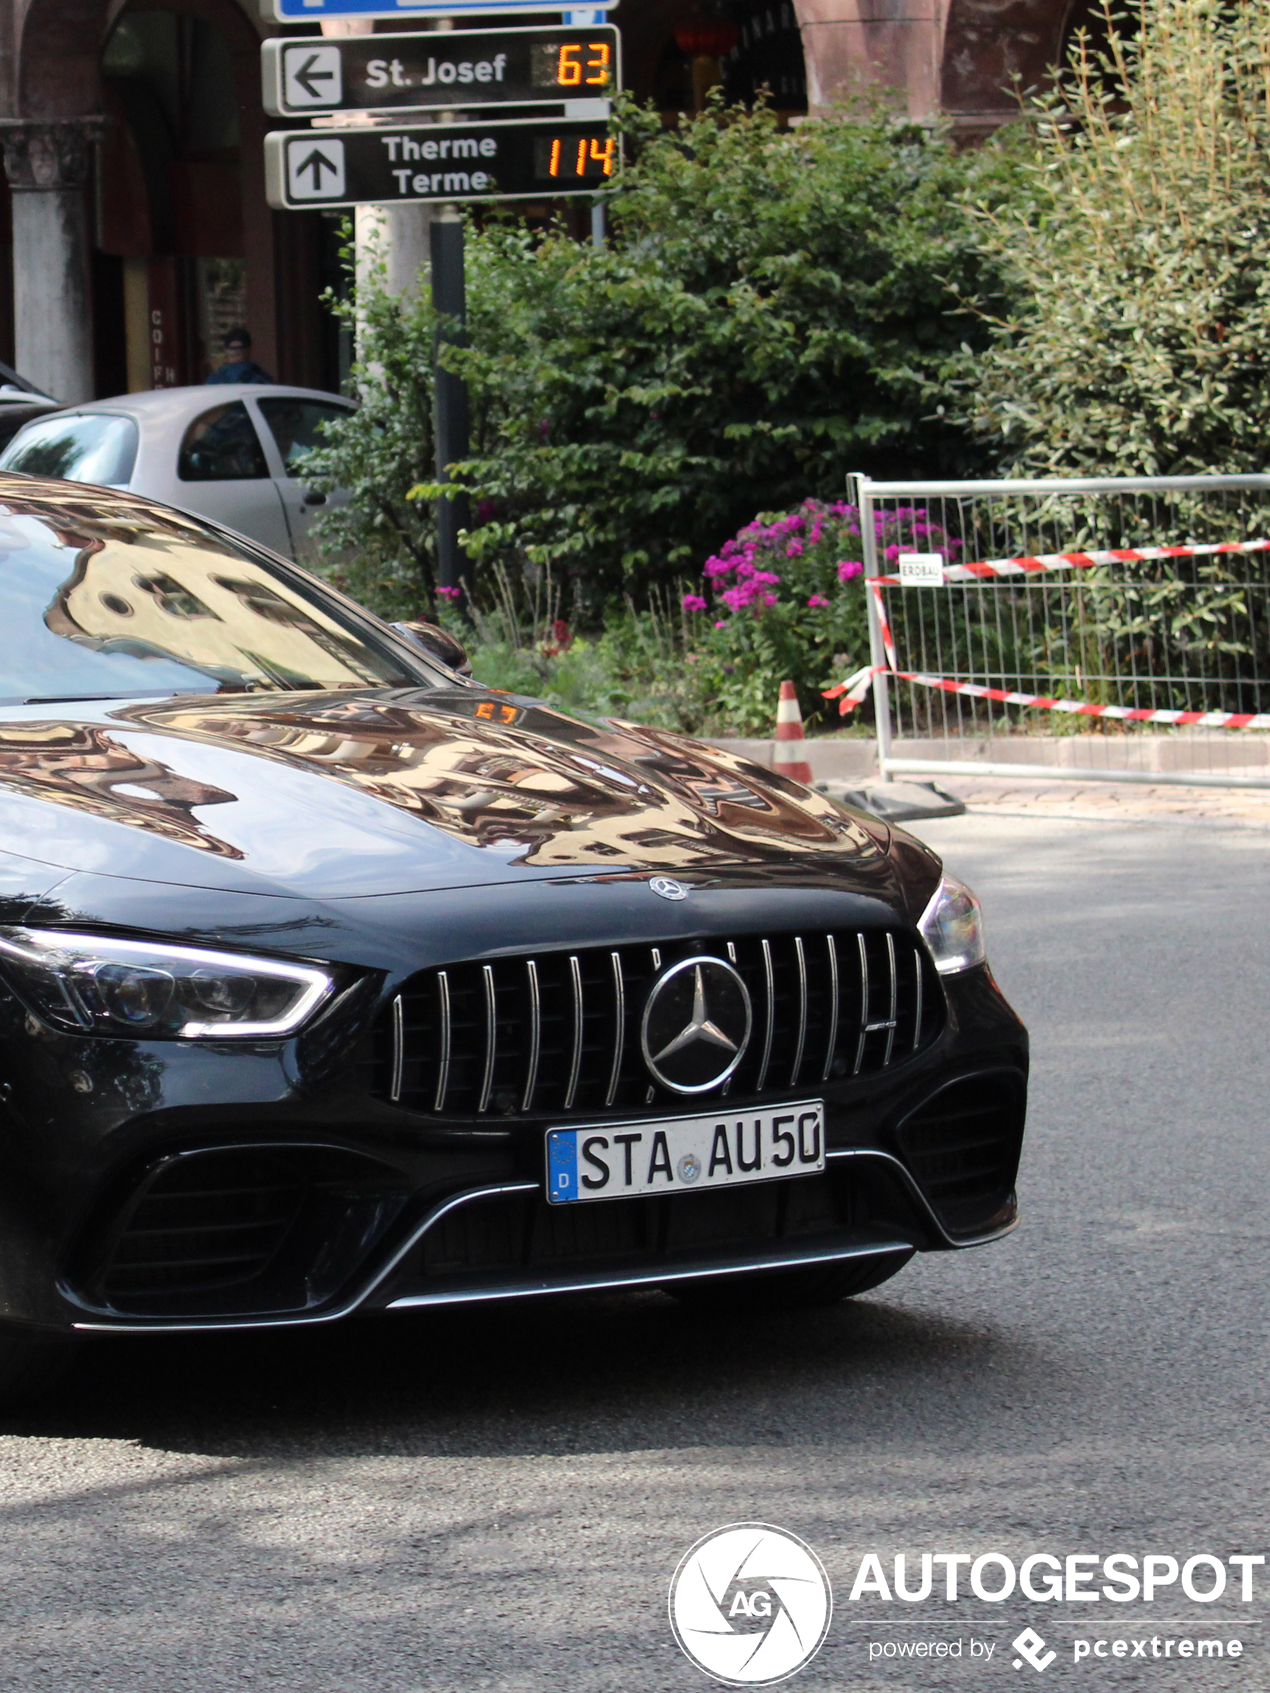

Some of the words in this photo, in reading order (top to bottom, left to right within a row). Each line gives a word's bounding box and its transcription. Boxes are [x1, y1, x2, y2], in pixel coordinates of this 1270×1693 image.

[365, 58, 412, 88] St.
[421, 53, 507, 86] Josef
[556, 43, 610, 86] 63
[381, 136, 498, 162] Therme
[548, 137, 615, 177] 114
[392, 169, 489, 195] Terme
[581, 1130, 674, 1190] STA
[558, 1172, 569, 1189] D
